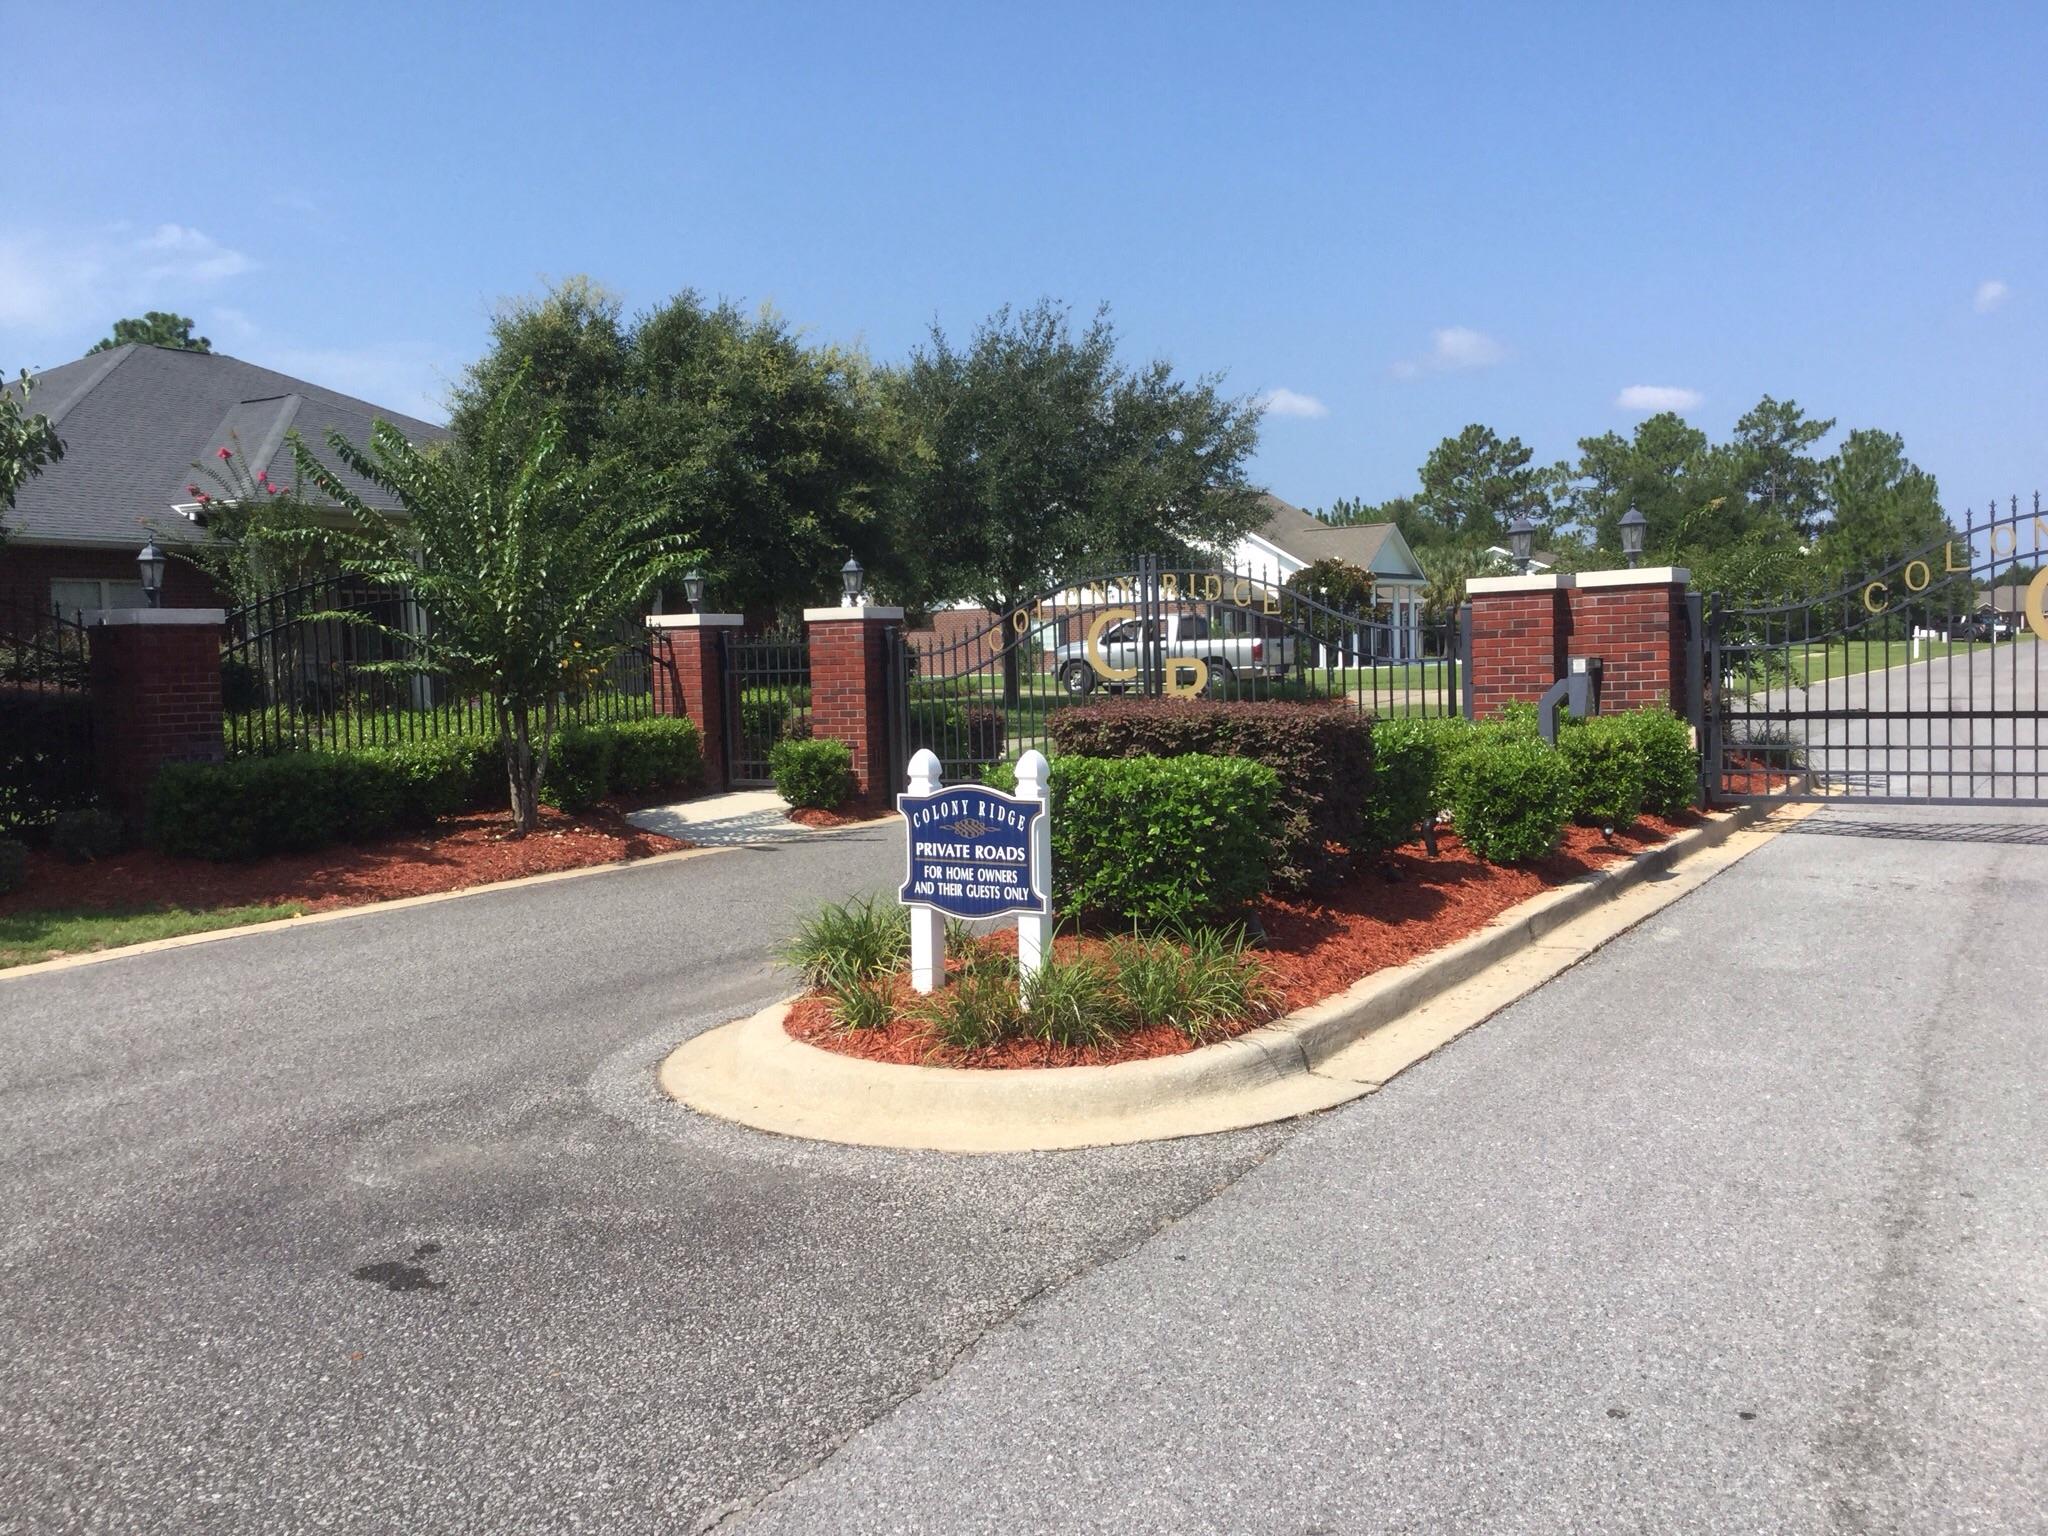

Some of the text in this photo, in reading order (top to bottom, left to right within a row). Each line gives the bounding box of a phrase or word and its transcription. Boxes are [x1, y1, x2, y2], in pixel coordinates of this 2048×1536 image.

[1162, 573, 1281, 615] RIDGE
[913, 799, 1026, 832] COLONY RIDGE
[916, 842, 1026, 861] PRIVATE ROADS
[924, 865, 1018, 884] FOR HOME OWNERS
[914, 881, 1029, 901] AND THEIR GUESTS ONLY
